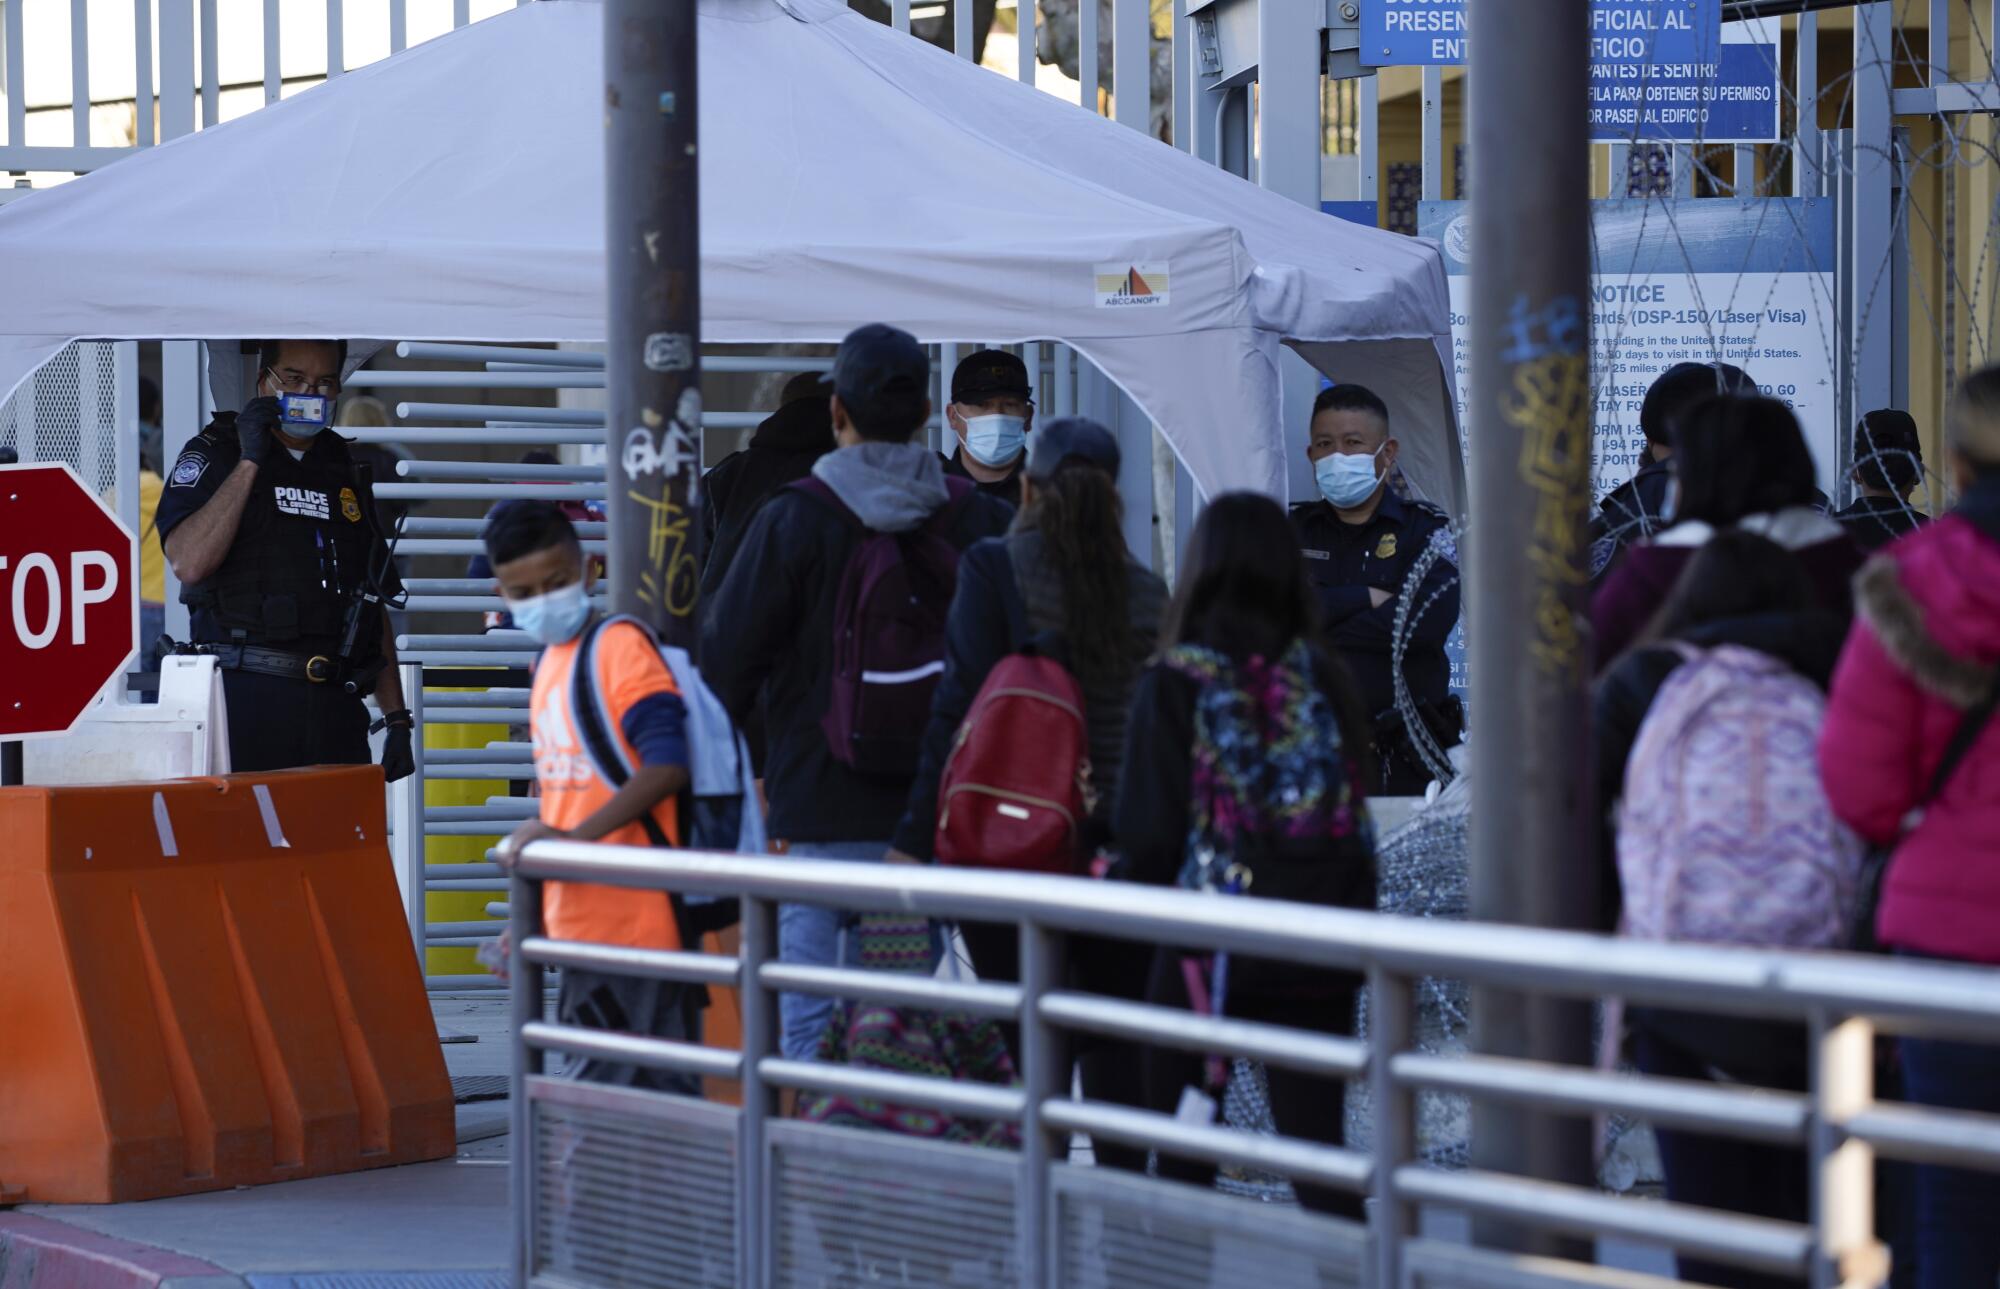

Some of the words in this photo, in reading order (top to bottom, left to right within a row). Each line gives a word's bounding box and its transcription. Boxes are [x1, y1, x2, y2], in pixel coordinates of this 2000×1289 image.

[1588, 9, 1660, 30] FICIAL
[1663, 10, 1692, 30] AL
[1641, 64, 1660, 78] DE
[1588, 86, 1611, 101] FILA
[1613, 86, 1643, 101] PARA
[1646, 86, 1699, 101] OBTENER
[1702, 86, 1717, 101] SU
[1720, 86, 1771, 101] PERMISO
[1605, 108, 1642, 123] PASEN
[1643, 108, 1659, 123] AL
[1588, 284, 1665, 302] NOTICE
[1105, 296, 1161, 306] ABCCANOPY
[1588, 310, 1625, 324] ards
[1631, 309, 1765, 327] (DSP-150/Laser
[1767, 308, 1806, 326] Visa)
[1603, 335, 1645, 348] residing
[1647, 335, 1657, 345] in
[1660, 335, 1678, 345] the
[1681, 335, 1715, 345] United
[1625, 349, 1649, 361] days
[1652, 349, 1664, 359] to
[1667, 348, 1689, 359] visit
[1692, 349, 1702, 359] in
[1705, 348, 1724, 359] the
[1726, 348, 1760, 359] United
[1763, 348, 1802, 358] States.
[1612, 363, 1627, 373] 25
[1629, 363, 1658, 373] miles
[1756, 384, 1773, 396] TO
[1777, 384, 1796, 396] GO
[1602, 439, 1627, 451] I-94
[1602, 454, 1638, 466] PORT
[274, 486, 329, 507] POLICE
[0, 550, 119, 650] OP
